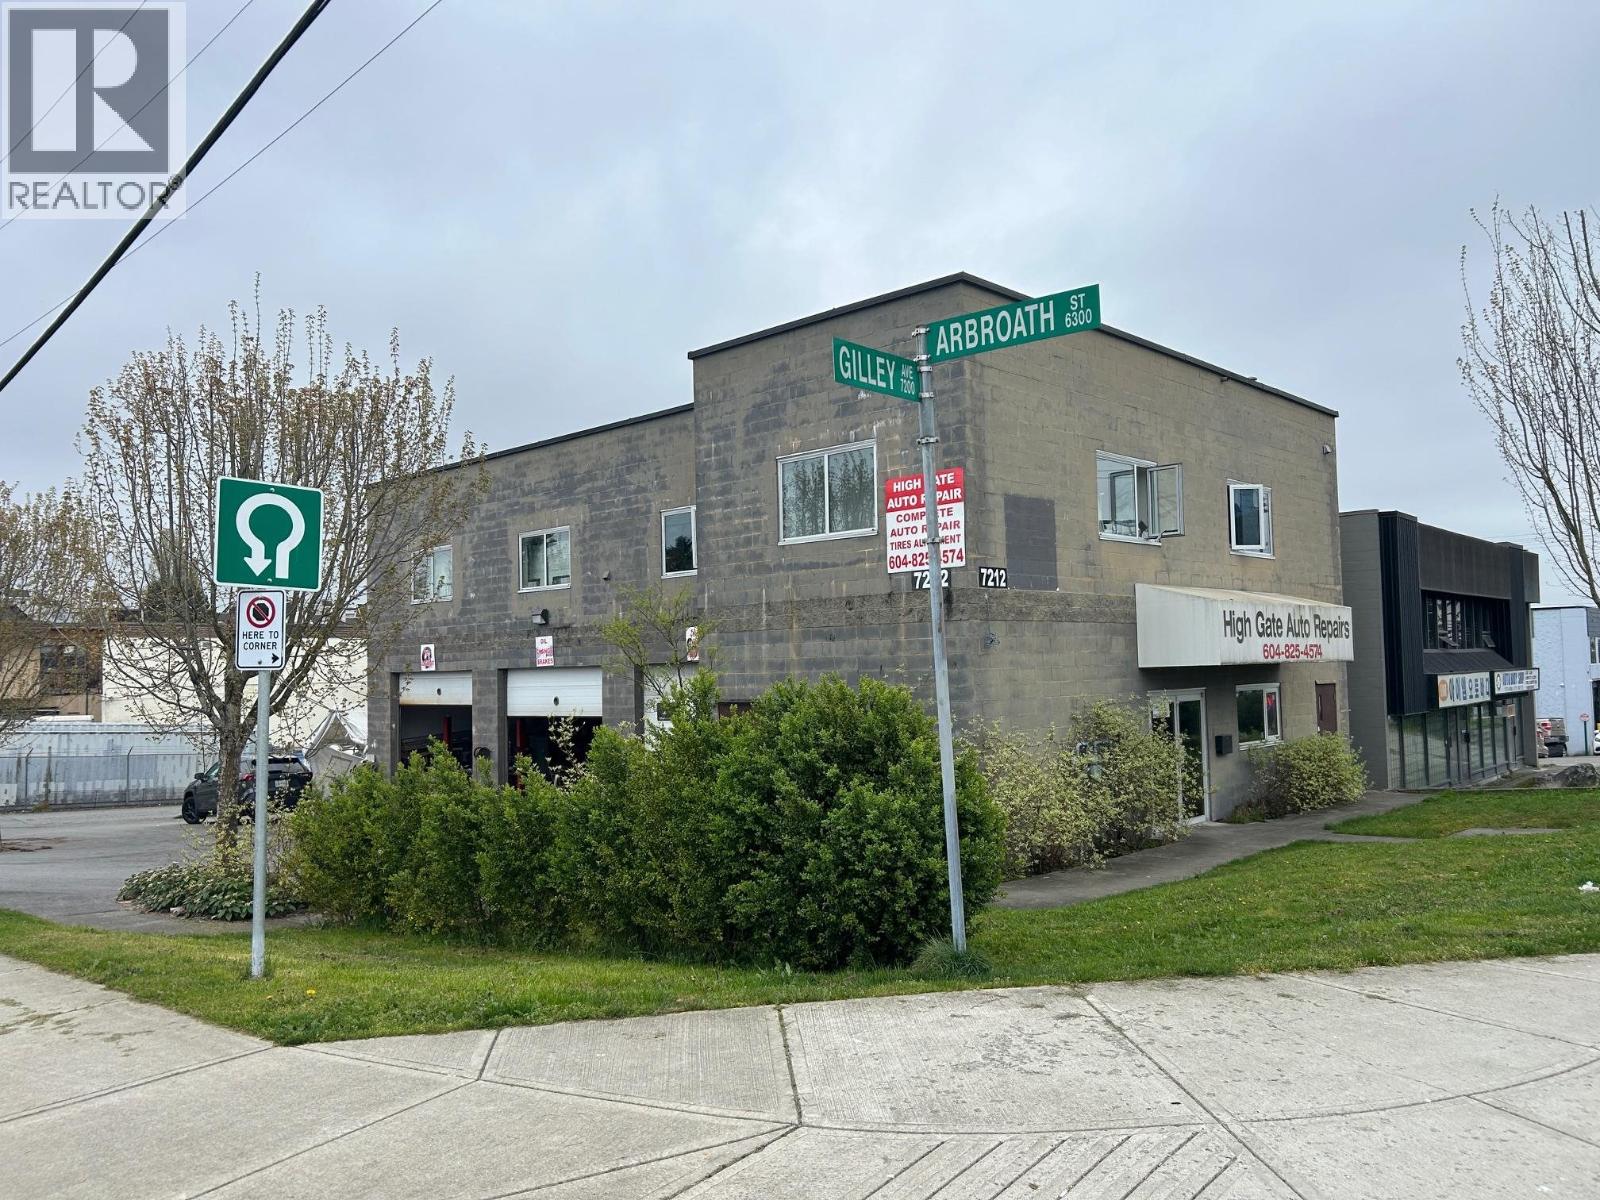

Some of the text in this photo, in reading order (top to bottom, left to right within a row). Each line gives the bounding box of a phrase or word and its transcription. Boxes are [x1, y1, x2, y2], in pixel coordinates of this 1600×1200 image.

[936, 293, 1086, 356] ARBROATH ST
[1064, 308, 1093, 328] 6300
[839, 345, 914, 390] GILLEY AVE
[900, 378, 916, 395] 7200
[893, 472, 955, 493] HIGH ATE
[887, 488, 962, 510] AUTO RPAIR
[896, 507, 954, 523] COMPTE
[890, 520, 961, 538] AUTO RPAIR
[890, 539, 912, 551] TIRES
[913, 569, 949, 589] 722
[980, 568, 1007, 587] 7212
[242, 631, 279, 639] HERE TO
[1222, 610, 1350, 643] High Gate Auto Repairs
[243, 641, 278, 650] CORNER
[1263, 643, 1323, 660] 604-825-4574
